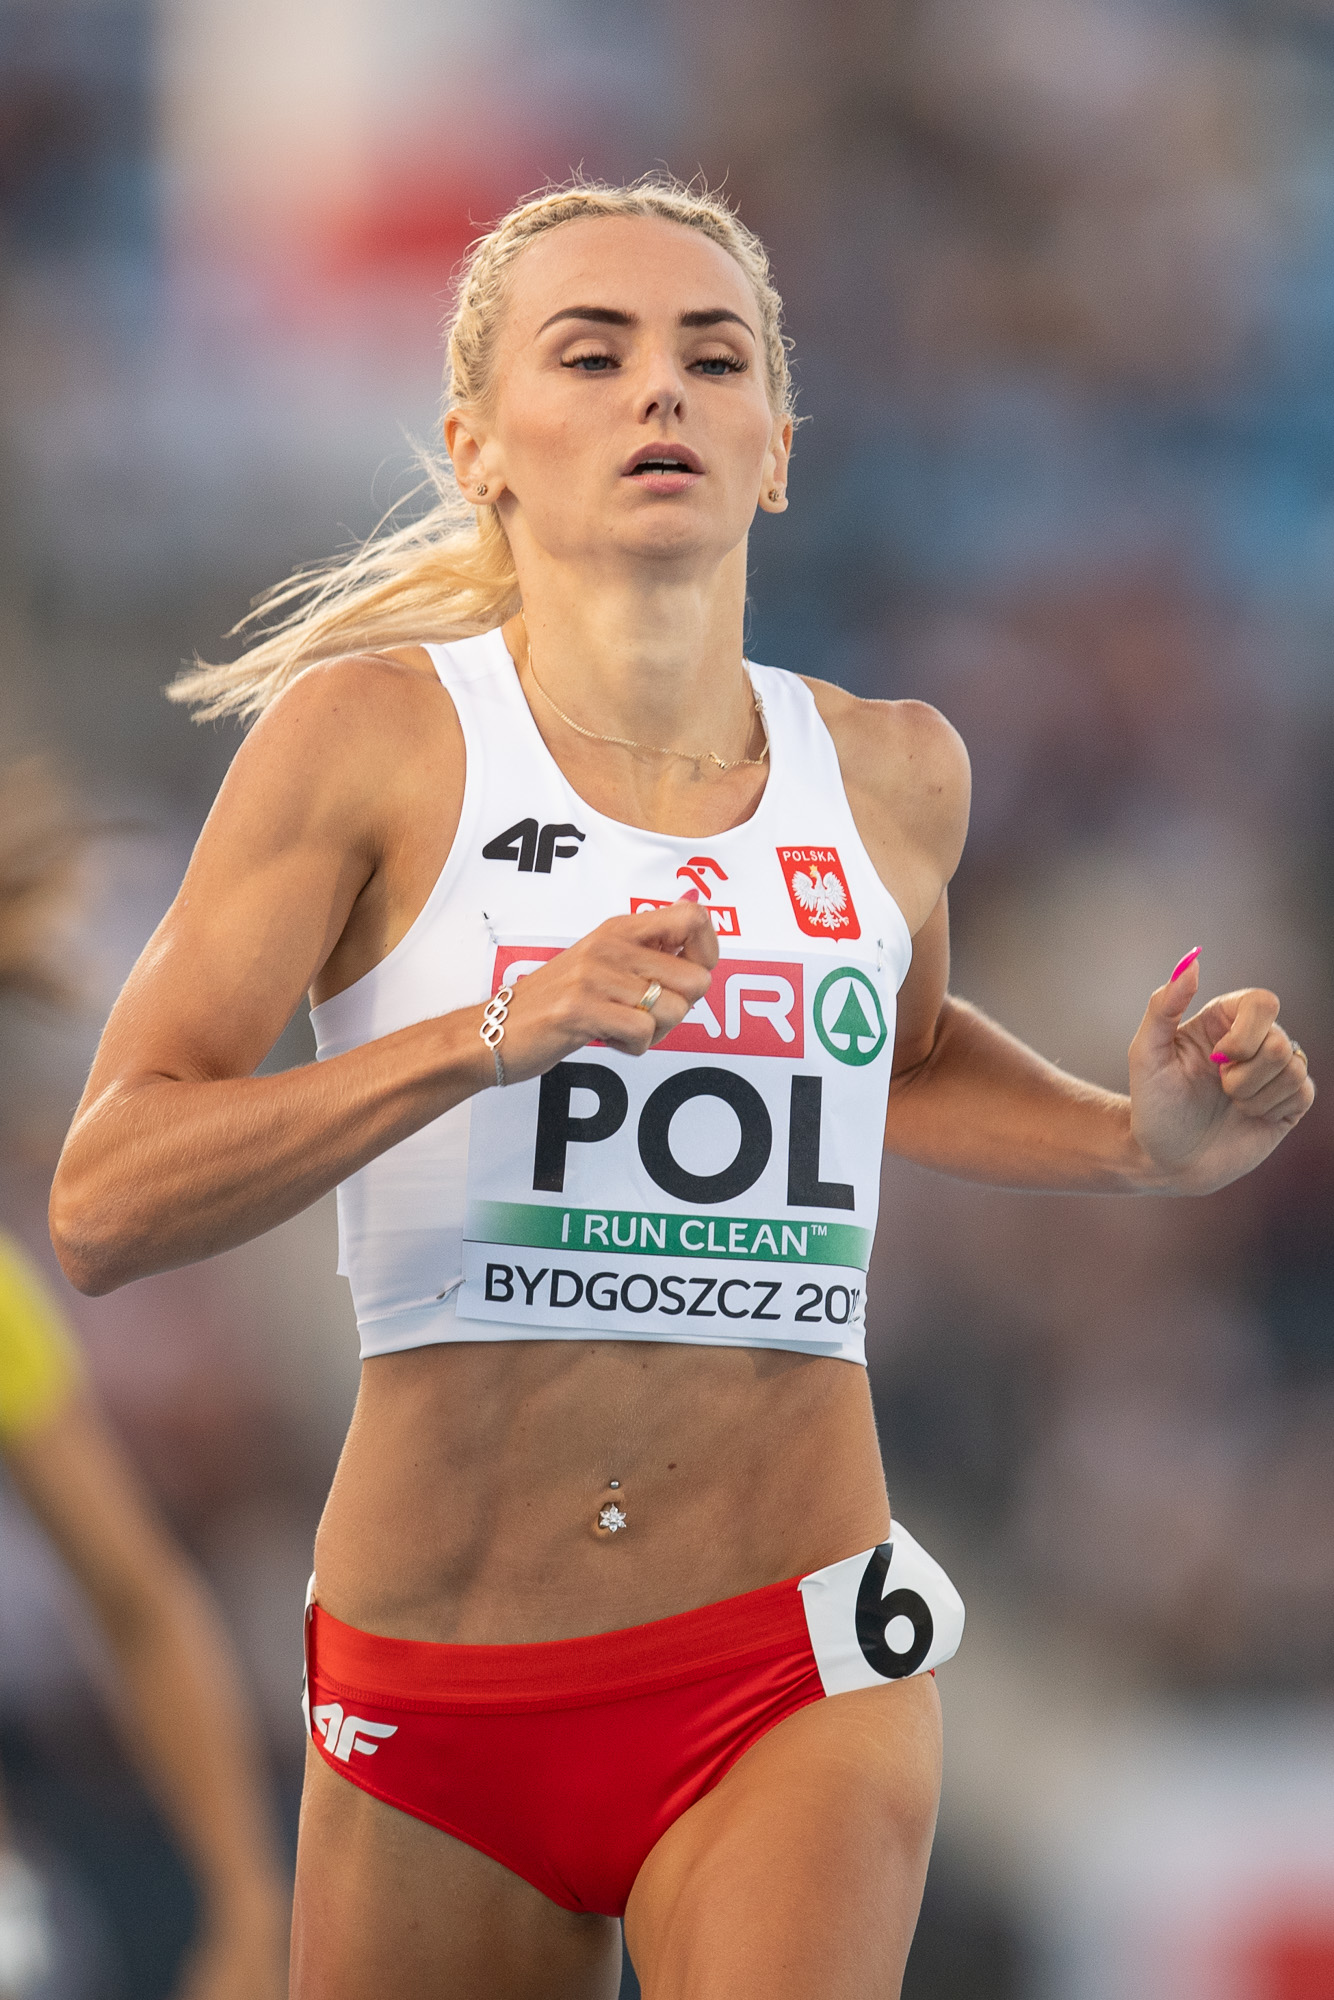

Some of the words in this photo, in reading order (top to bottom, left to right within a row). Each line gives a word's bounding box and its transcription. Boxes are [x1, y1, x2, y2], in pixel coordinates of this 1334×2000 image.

[482, 817, 586, 873] 4F
[782, 850, 836, 862] POLSKA
[532, 1061, 856, 1212] POL
[561, 1213, 571, 1243] I
[584, 1214, 667, 1249] RUN
[484, 1263, 783, 1321] BYDGOSZCZ
[855, 1542, 934, 1679] 6
